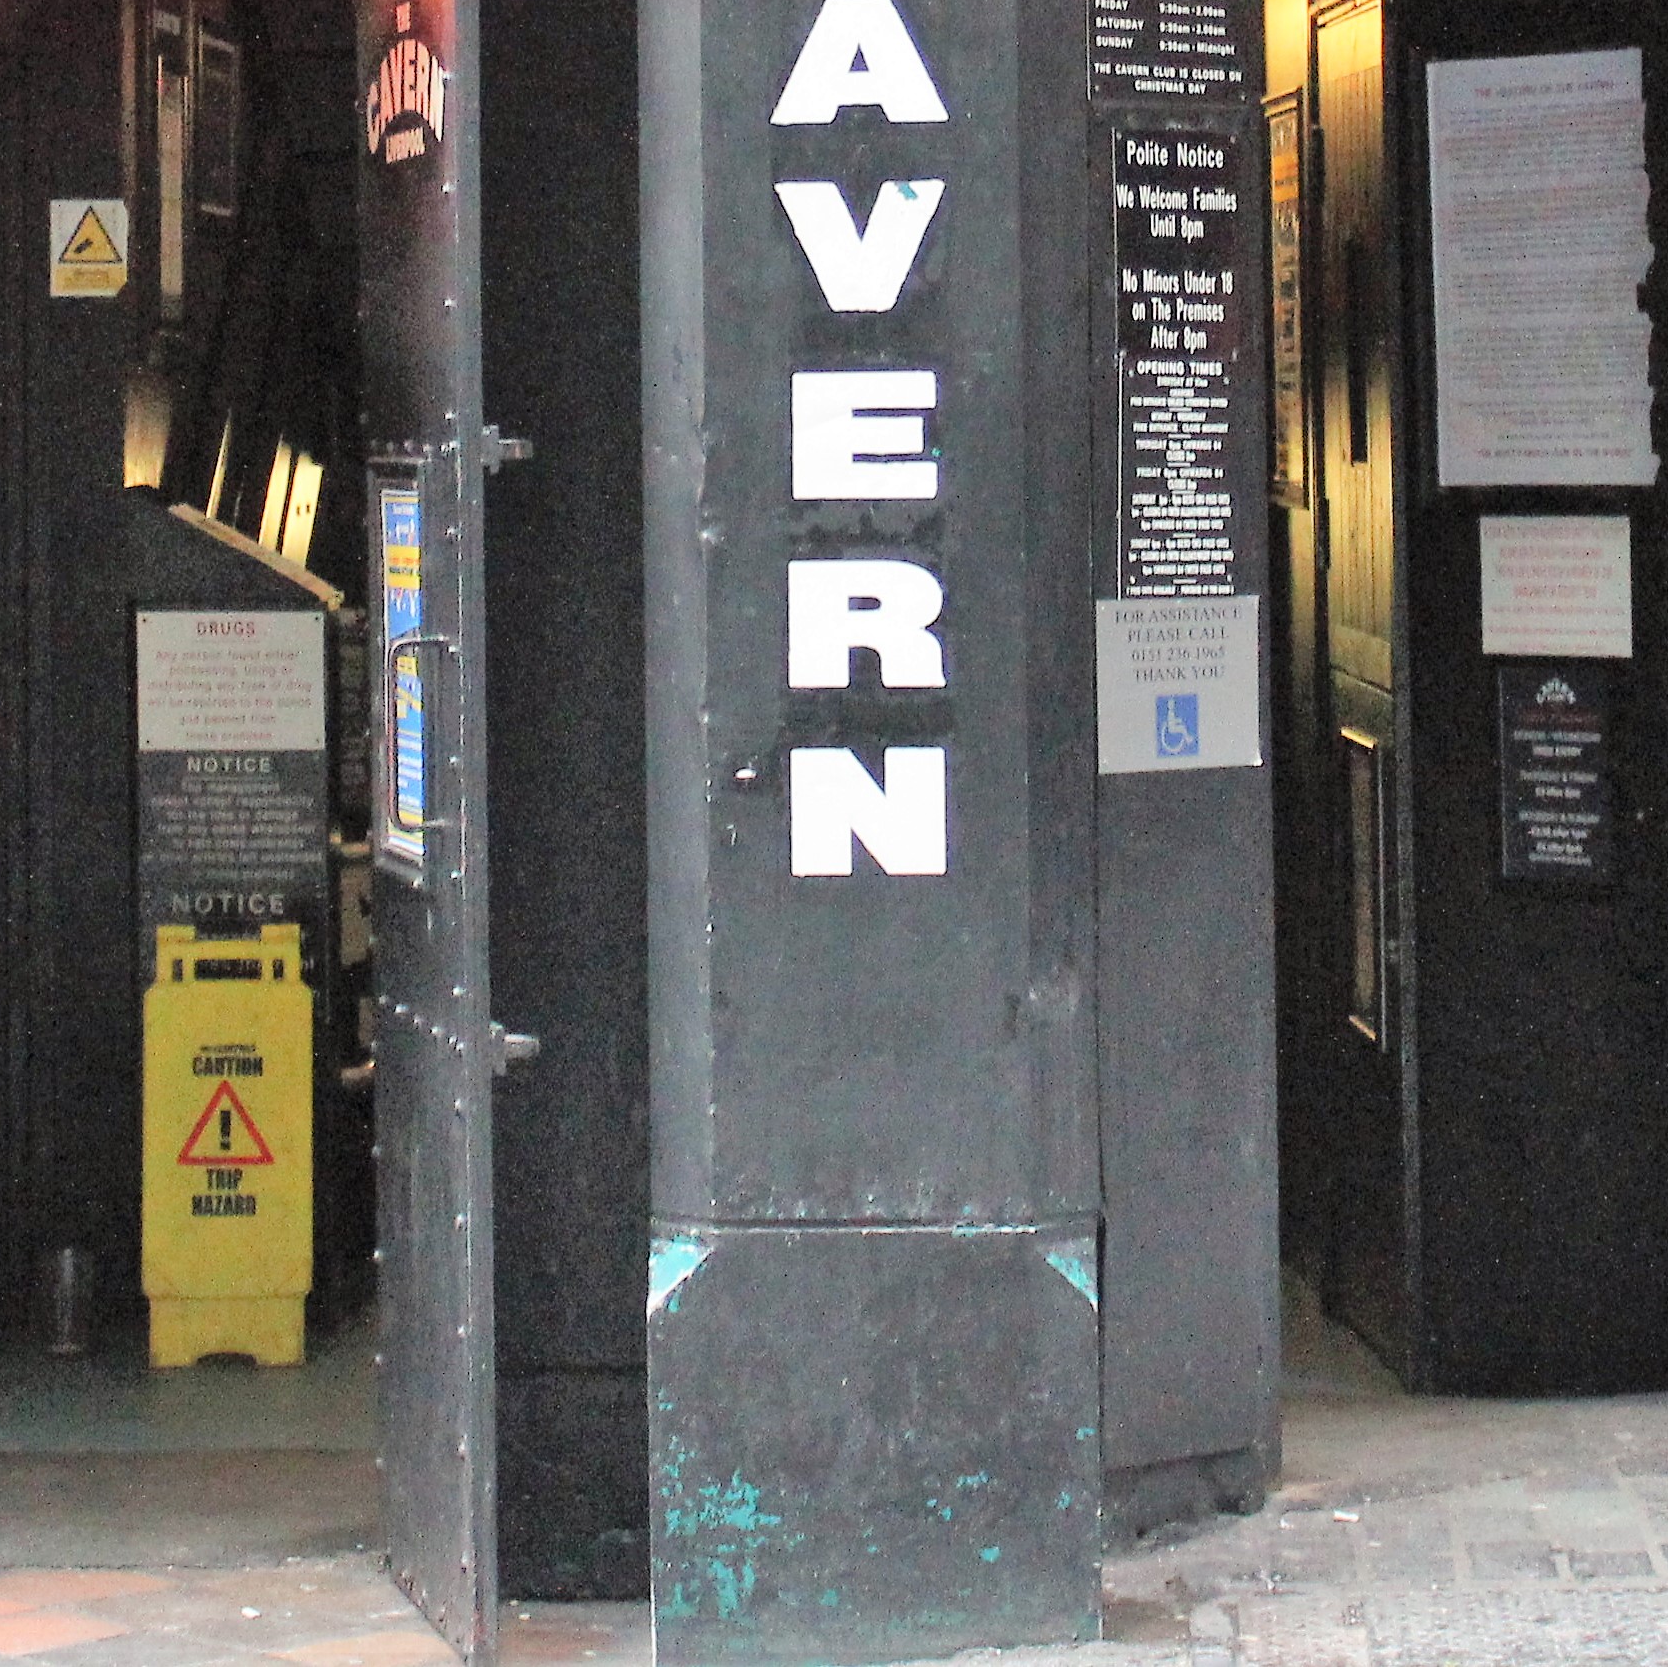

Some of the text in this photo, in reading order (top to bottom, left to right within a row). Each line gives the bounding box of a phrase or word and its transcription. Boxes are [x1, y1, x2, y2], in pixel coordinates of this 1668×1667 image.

[1094, 16, 1144, 30] SATURDAY
[1094, 35, 1133, 49] SUNDAY
[1094, 62, 1242, 82] THE CAVERN CLUB IS CLOSED ON
[367, 39, 445, 155] CAVERN
[1134, 80, 1206, 94] CHRISTMAS DAY
[1127, 140, 1224, 168] Polite Notice
[1116, 185, 1237, 212] We Welcome Families
[1150, 214, 1204, 244] Until 8pm
[1122, 269, 1233, 295] No Minors Under 18
[1132, 297, 1225, 322] on The Premises
[1151, 326, 1207, 354] After 8pm
[1137, 360, 1223, 376] OPENING TIMES
[1115, 606, 1245, 624] FOR ASSISTANCE
[197, 621, 255, 636] DRUGS
[1127, 627, 1230, 643] PLEASE CALL
[1134, 666, 1225, 682] THANK YOU
[187, 757, 271, 773] NOTICE
[171, 893, 284, 915] NOTICE
[193, 1056, 263, 1077] CAUTION
[207, 1167, 243, 1190] TRIP
[191, 1194, 257, 1216] HAZARD
